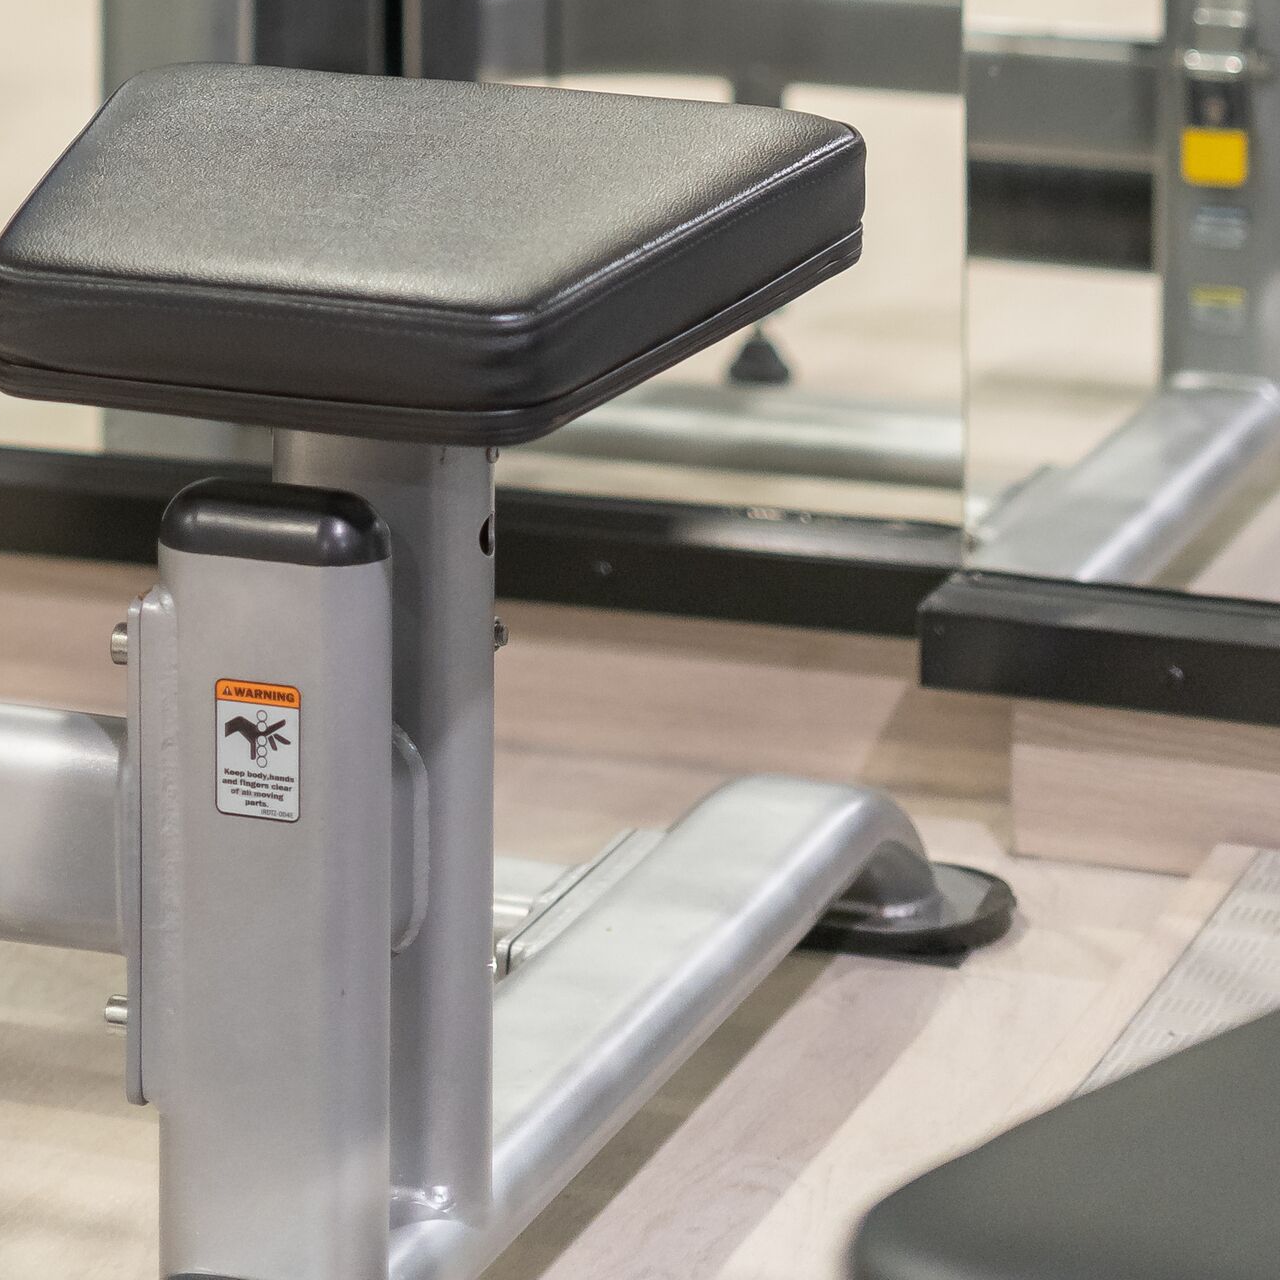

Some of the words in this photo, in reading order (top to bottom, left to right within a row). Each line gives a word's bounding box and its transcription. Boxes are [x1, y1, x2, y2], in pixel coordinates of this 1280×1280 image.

[233, 686, 295, 703] WARNING
[223, 768, 245, 778] Keep
[240, 779, 269, 789] fingers
[271, 783, 292, 792] clear
[253, 791, 284, 801] moving
[245, 799, 270, 808] parts.
